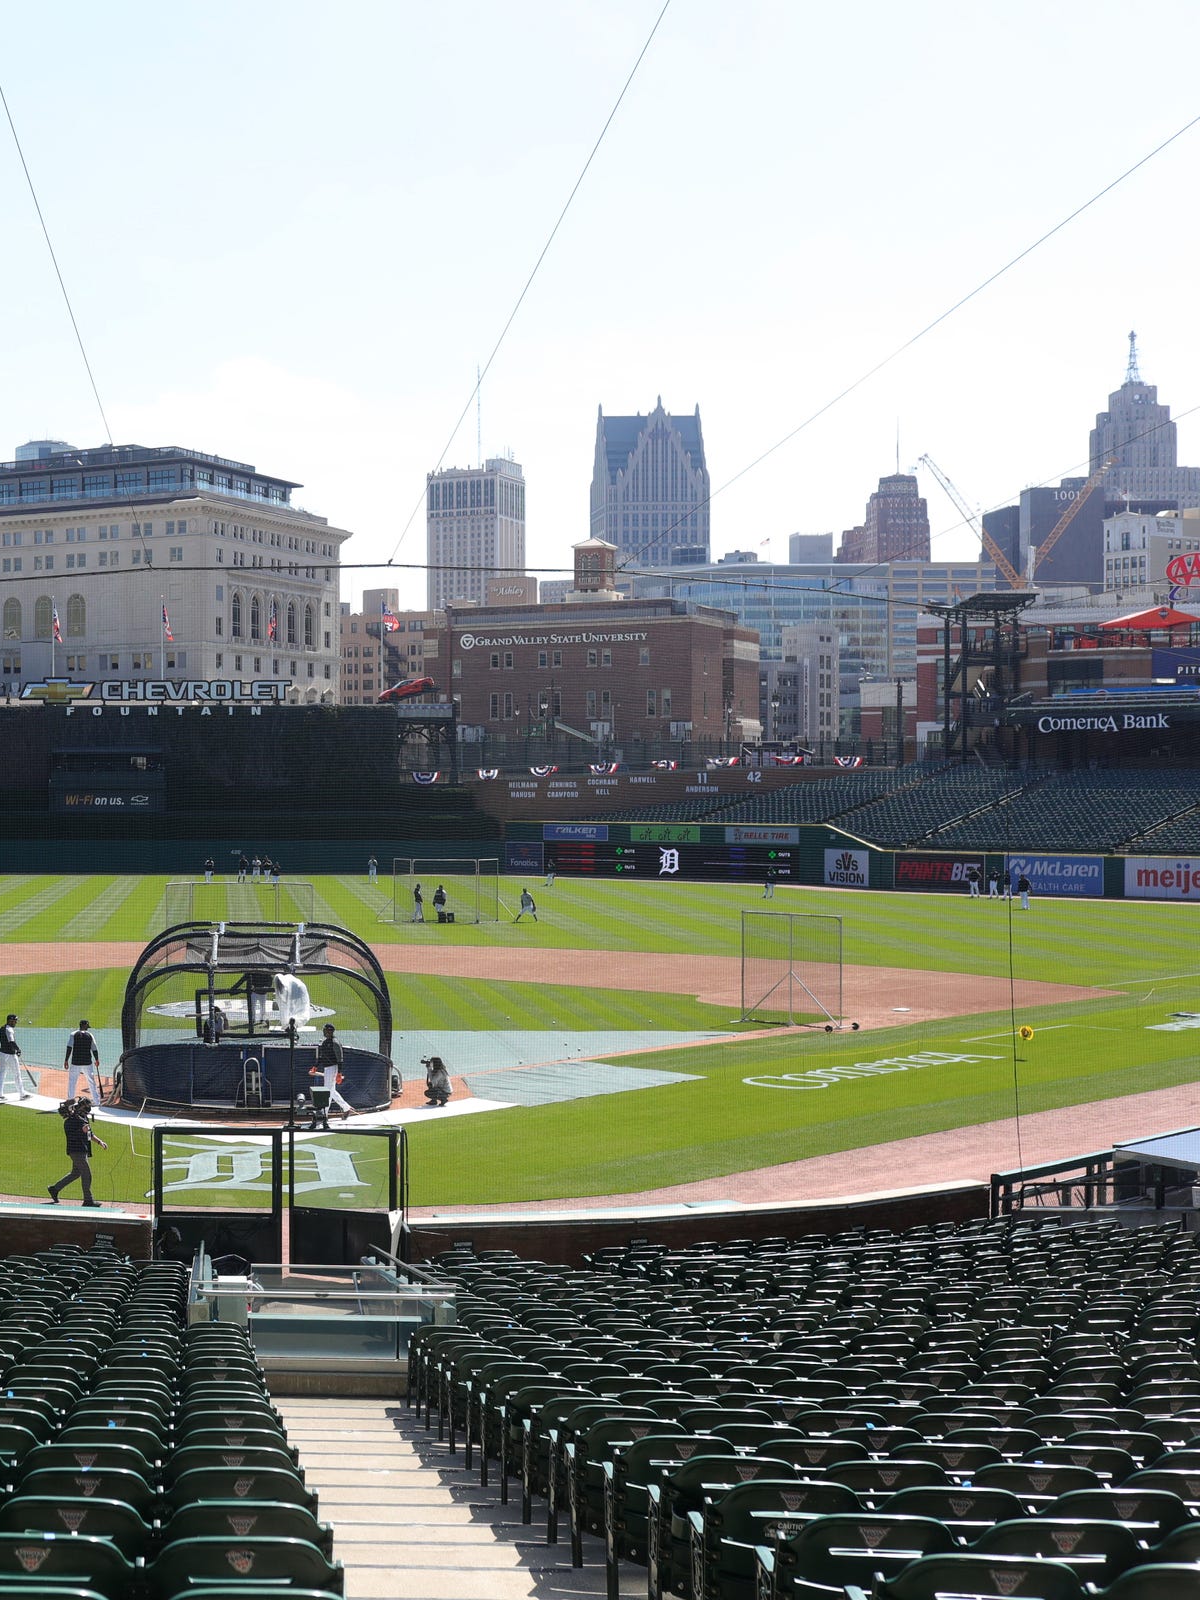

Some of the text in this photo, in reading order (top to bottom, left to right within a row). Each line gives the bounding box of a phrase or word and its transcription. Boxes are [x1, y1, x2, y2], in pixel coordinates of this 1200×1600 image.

[550, 633, 582, 643] STATE
[582, 631, 648, 643] UNIVERSITY
[100, 680, 292, 701] CHEVROLET
[66, 707, 262, 716] FOUNTAIN
[1123, 713, 1171, 729] Bank
[629, 776, 657, 784] HARWELL
[697, 773, 708, 784] 11
[747, 771, 762, 783] 42
[596, 788, 610, 796] KELL
[685, 785, 719, 793] ANDERSON
[65, 794, 125, 806] Wi-Fi on us.
[771, 832, 790, 840] TIRE
[510, 858, 539, 867] Fanatics
[1032, 863, 1099, 878] McLaren
[828, 872, 865, 884] VISION
[1031, 882, 1086, 891] EALTH CARE
